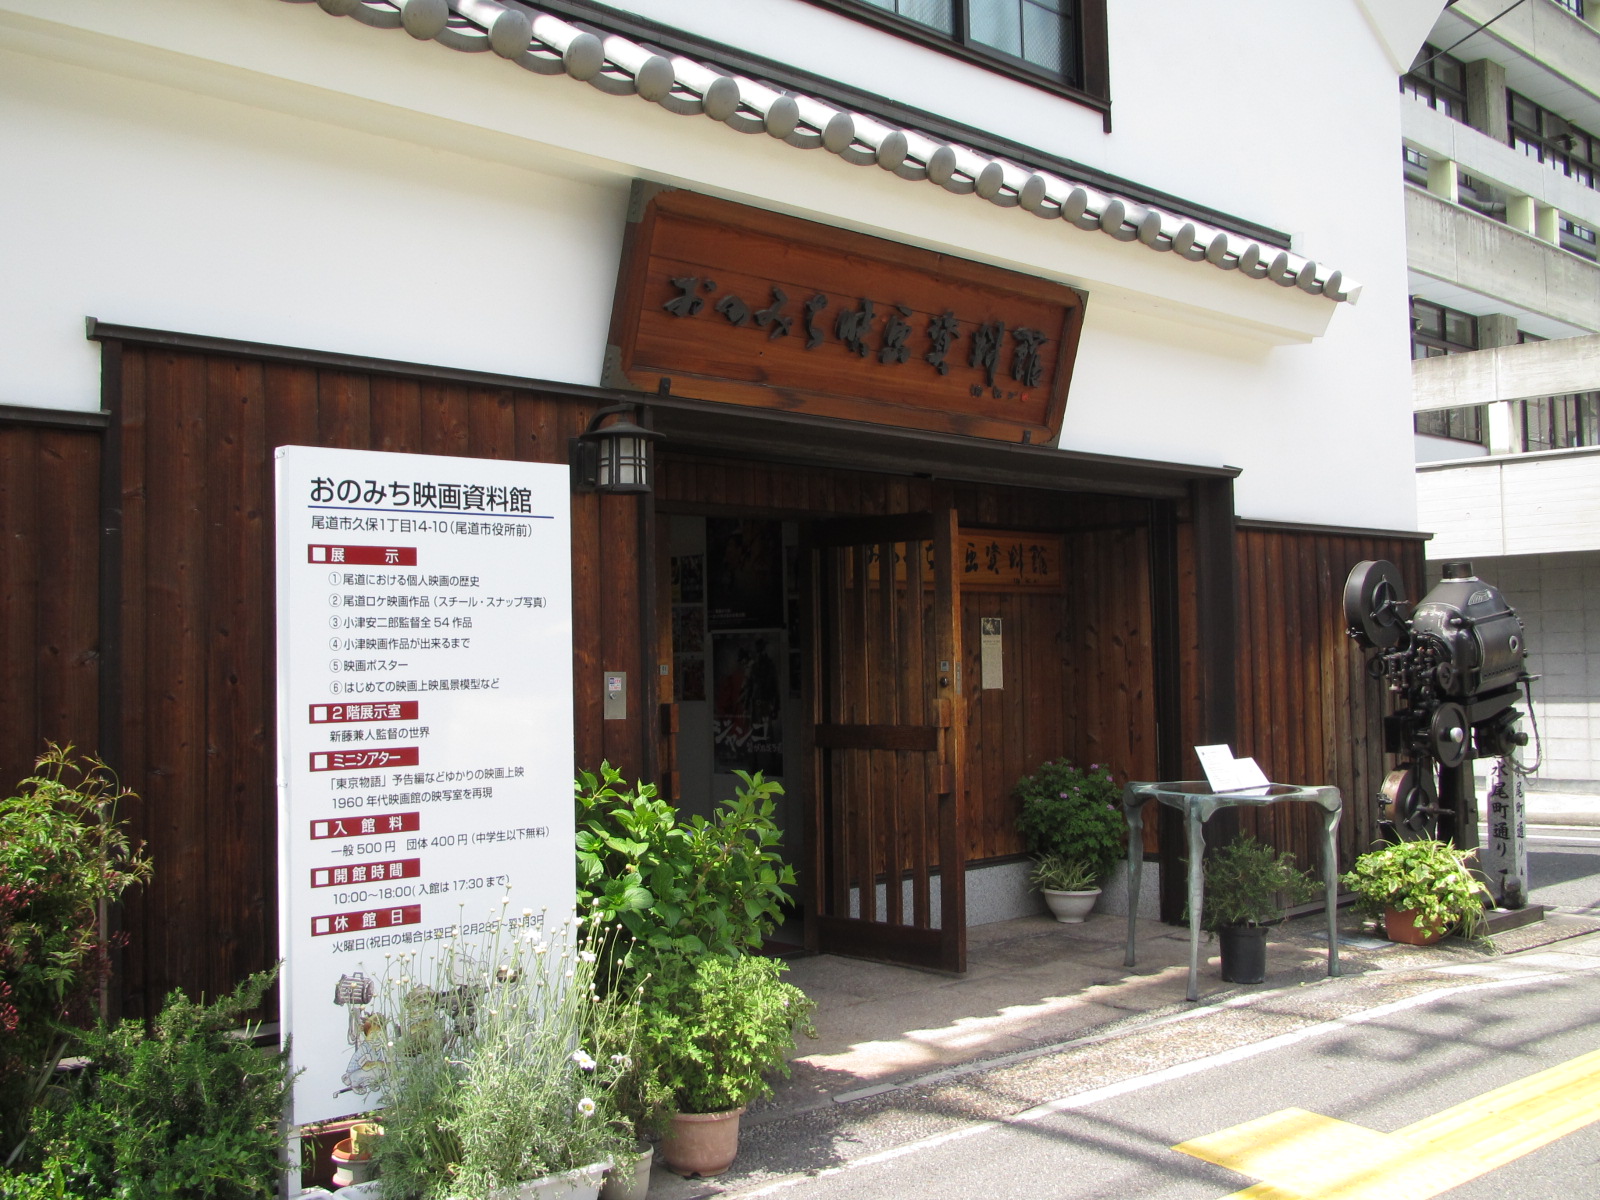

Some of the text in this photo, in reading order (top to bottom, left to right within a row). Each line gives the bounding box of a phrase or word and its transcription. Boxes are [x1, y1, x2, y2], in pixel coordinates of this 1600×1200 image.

[309, 476, 533, 514] おのみち映画資料館
[332, 703, 402, 721] 2階展示室
[329, 726, 430, 743] 新藤兼人監督の世界
[333, 751, 402, 768] ミニシアター
[333, 815, 403, 836] 入館料
[334, 862, 403, 884] 開館時間
[334, 909, 403, 932] 休館日
